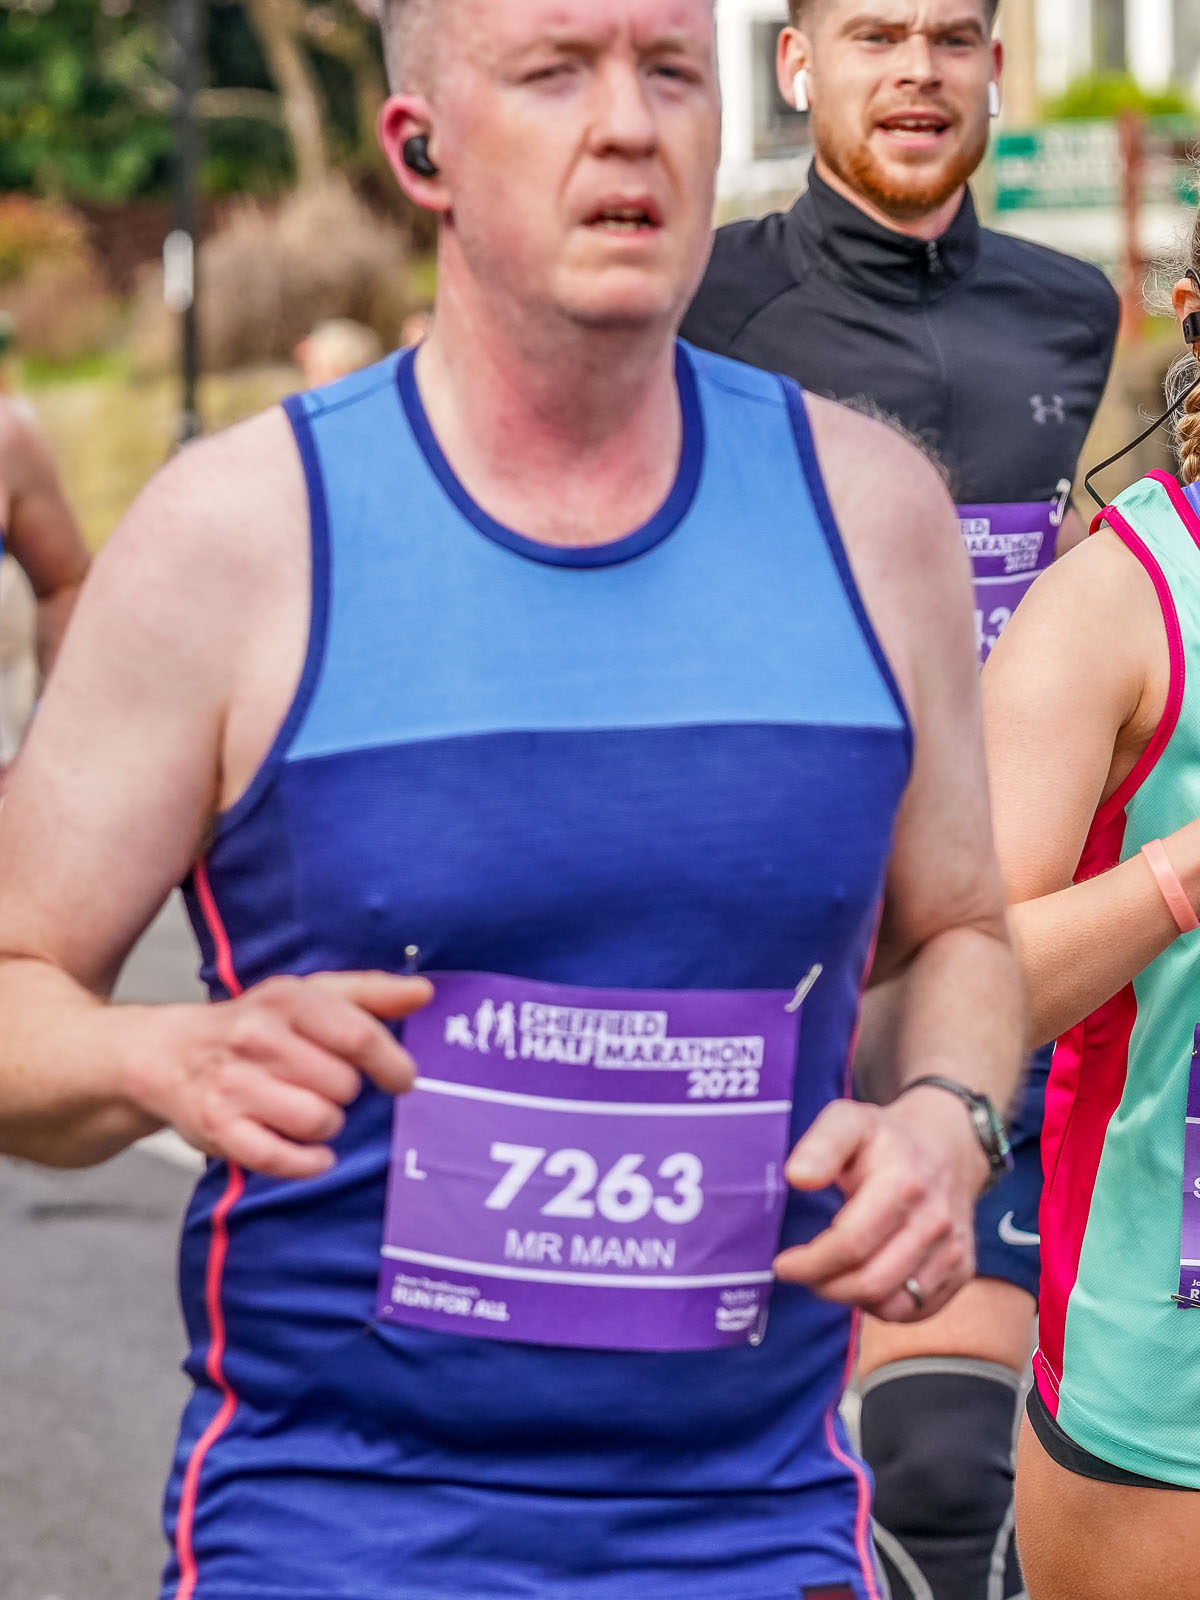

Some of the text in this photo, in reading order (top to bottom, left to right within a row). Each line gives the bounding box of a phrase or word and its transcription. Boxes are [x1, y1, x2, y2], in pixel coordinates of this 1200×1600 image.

[529, 1007, 660, 1036] SHEFFIELD
[520, 1033, 757, 1066] HALF MARATHON
[687, 1069, 760, 1098] 2022
[405, 1148, 427, 1180] L
[483, 1141, 704, 1224] 7263
[504, 1229, 677, 1270] MR MANN
